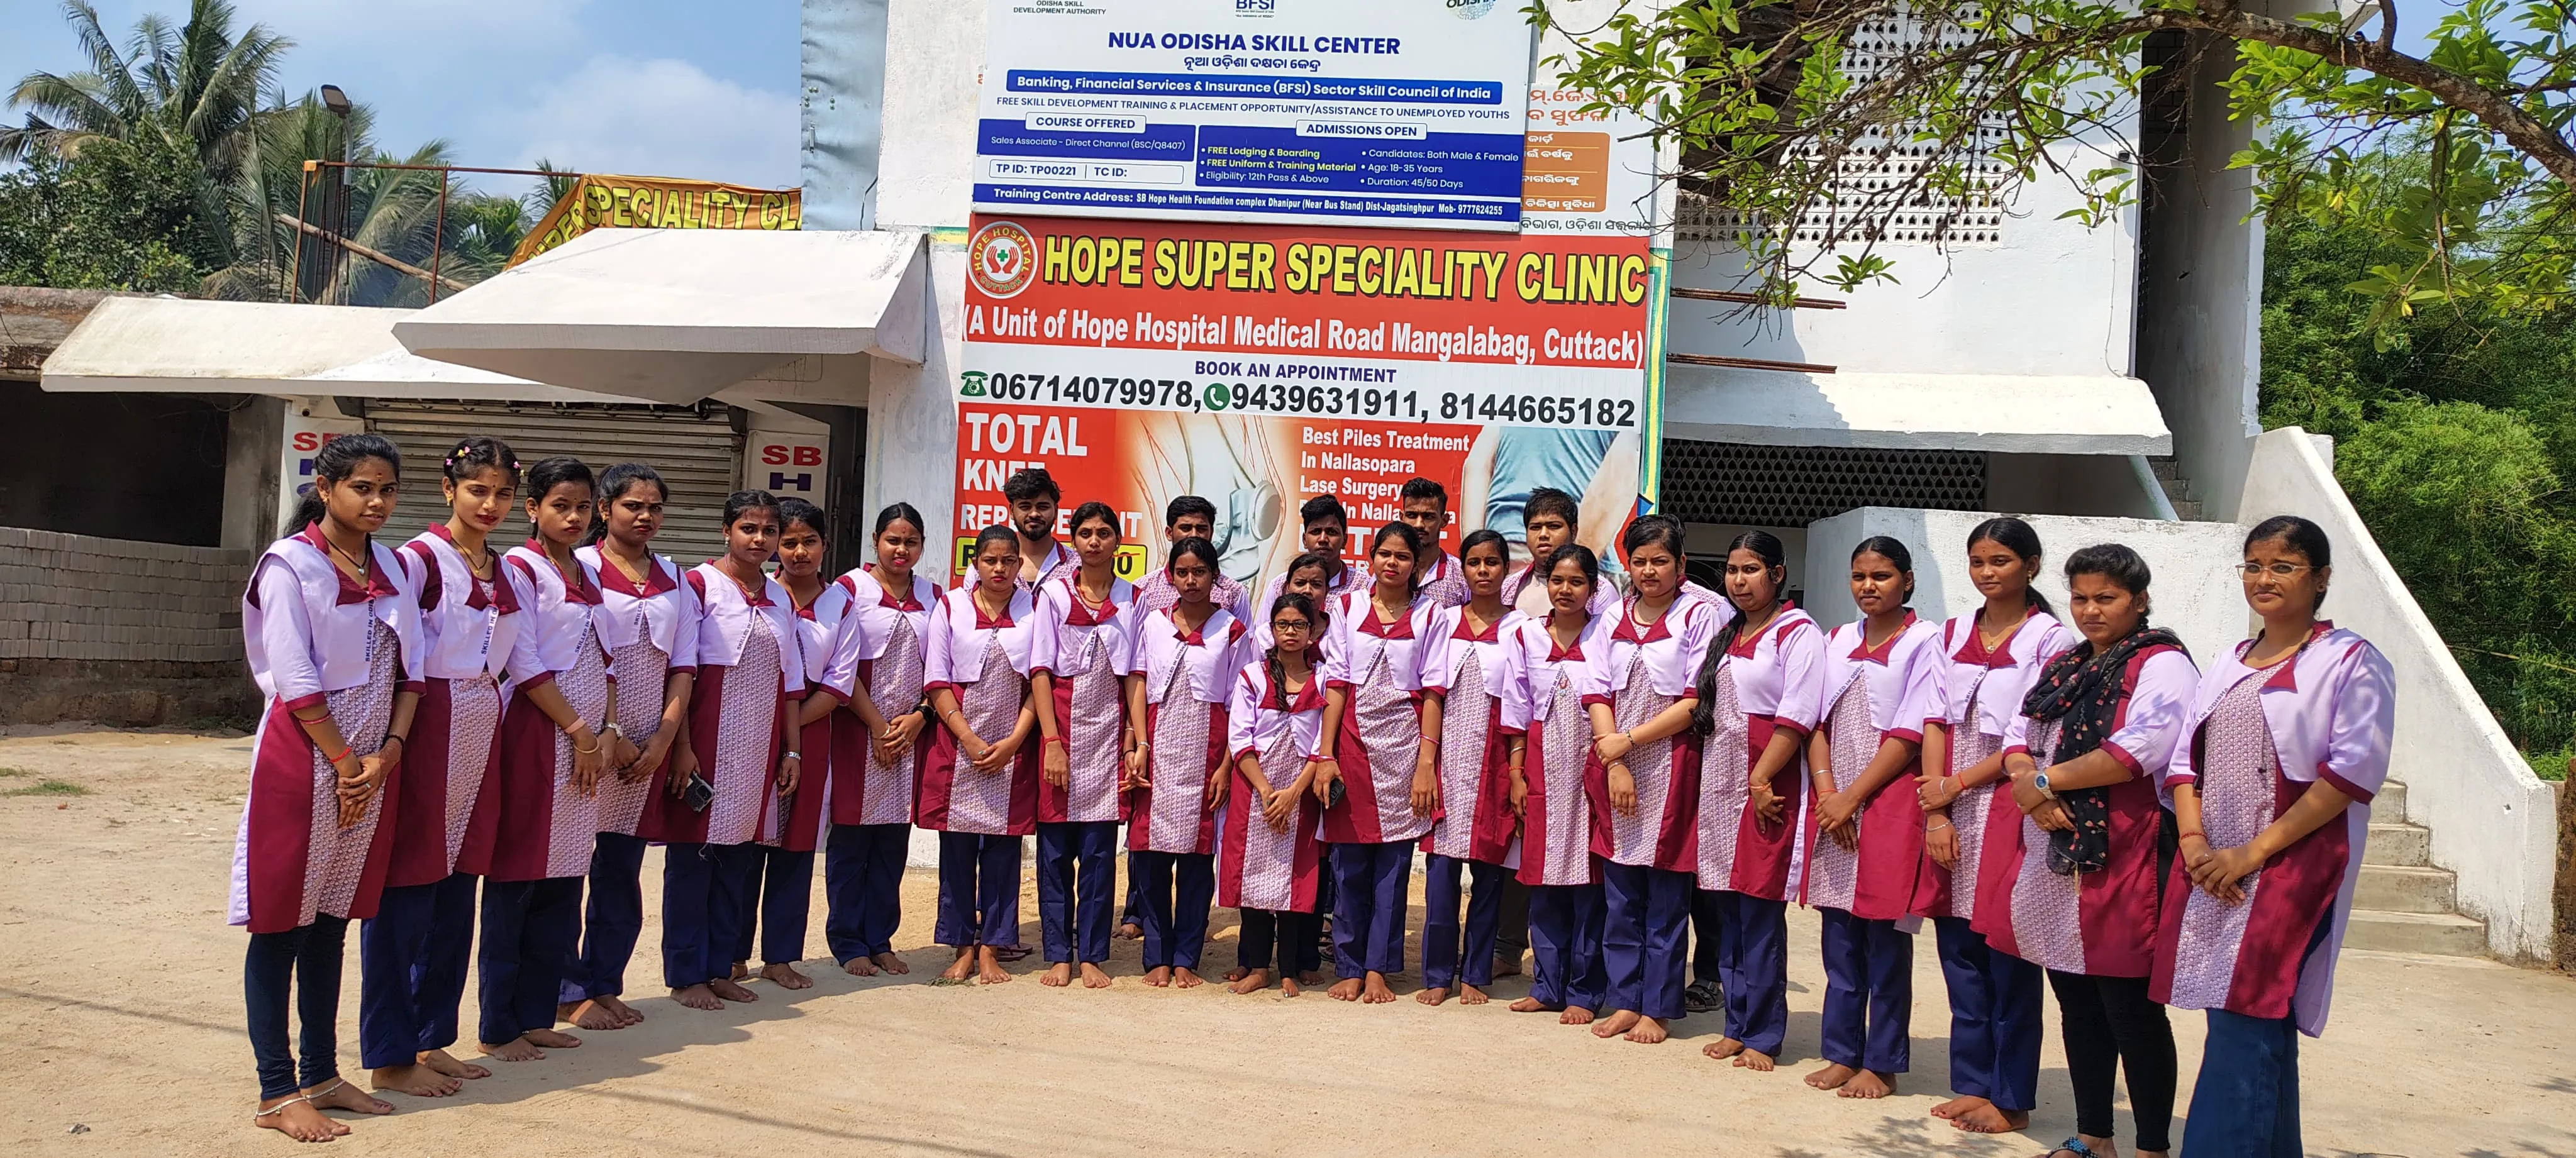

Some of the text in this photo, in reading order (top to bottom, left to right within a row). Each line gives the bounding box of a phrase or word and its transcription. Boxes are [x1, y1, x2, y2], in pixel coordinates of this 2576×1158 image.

[1109, 32, 1400, 54] NUA ODISHA SKILL CENTER
[1017, 76, 1491, 99] Banking, Financial Services & Insurance (BFSI) Sector Skill Council of India
[1048, 99, 1119, 108] DEVELOPMENT
[1121, 101, 1167, 109] TRAINING
[1180, 102, 1238, 111] PLACEMENT
[1240, 103, 1377, 116] OPPORTUNITY/ASSISTANCE
[1397, 108, 1465, 118] UNEMPLOYED
[1468, 110, 1509, 119] YOUTHS
[1036, 117, 1135, 128] COURSE OFFERED
[1306, 124, 1417, 136] ADMISSIONS OPEN
[991, 136, 1014, 145] Sales
[1015, 137, 1057, 146] Associate
[1065, 138, 1091, 147] Direct
[1092, 140, 1130, 148] Channel
[1131, 138, 1185, 151] (BSC/Q8407)
[1208, 146, 1228, 155] FREE
[1230, 146, 1267, 158] Lodging
[1277, 148, 1320, 160] Boarding
[1207, 158, 1227, 167] FREE
[1229, 159, 1266, 168] Uniform
[1276, 160, 1315, 172] Training
[1315, 162, 1356, 172] Material
[1368, 149, 1425, 158] Candidates:
[1427, 150, 1448, 159] Both
[1450, 152, 1473, 160] Male
[1475, 152, 1482, 160] &
[1484, 152, 1519, 162] Female
[996, 164, 1076, 175] TP ID: TP00221
[1094, 167, 1127, 177] TC ID:
[1206, 170, 1330, 184] Eligibility: 12th Pass & Above
[1367, 163, 1443, 174] Age: 18-35 Years
[1367, 177, 1463, 190] Duration: 45/50 Days
[584, 184, 752, 230] SPECIALITY
[994, 187, 1503, 216] Training Centre Address: SB Hope Health Foundation complex Dhanipur (Near Bus Stand) Dist-Jagatsinghpur Mob- 9777624255
[974, 228, 1031, 272] HOPE HOSPITAL
[1043, 235, 1647, 307] HOPE SUPER SPECIALITY CLINIC
[980, 277, 1023, 292] CUTTACK
[962, 304, 1644, 369] (A Unit of Hope Hospital Medical Road Mangalabag, Cuttack)
[1196, 361, 1397, 383] BOOK AN APPOINTMENT
[990, 373, 1636, 427] 06714079978, 9439631911, 8144665182
[965, 412, 1087, 456] TOTAL
[1302, 426, 1470, 451] Best Piles Treatment
[762, 444, 822, 466] SB
[1301, 451, 1415, 476] In Nallasopara
[769, 472, 812, 491] H
[1300, 475, 1403, 501] Lase Surgery
[368, 619, 373, 628] IN
[634, 601, 644, 625] SKILLED
[480, 626, 493, 655] SKILLED
[489, 616, 496, 624] IN
[574, 628, 588, 654] SKILLED
[1828, 685, 1846, 706] SKILLED
[2199, 687, 2229, 719] IN ODISHA
